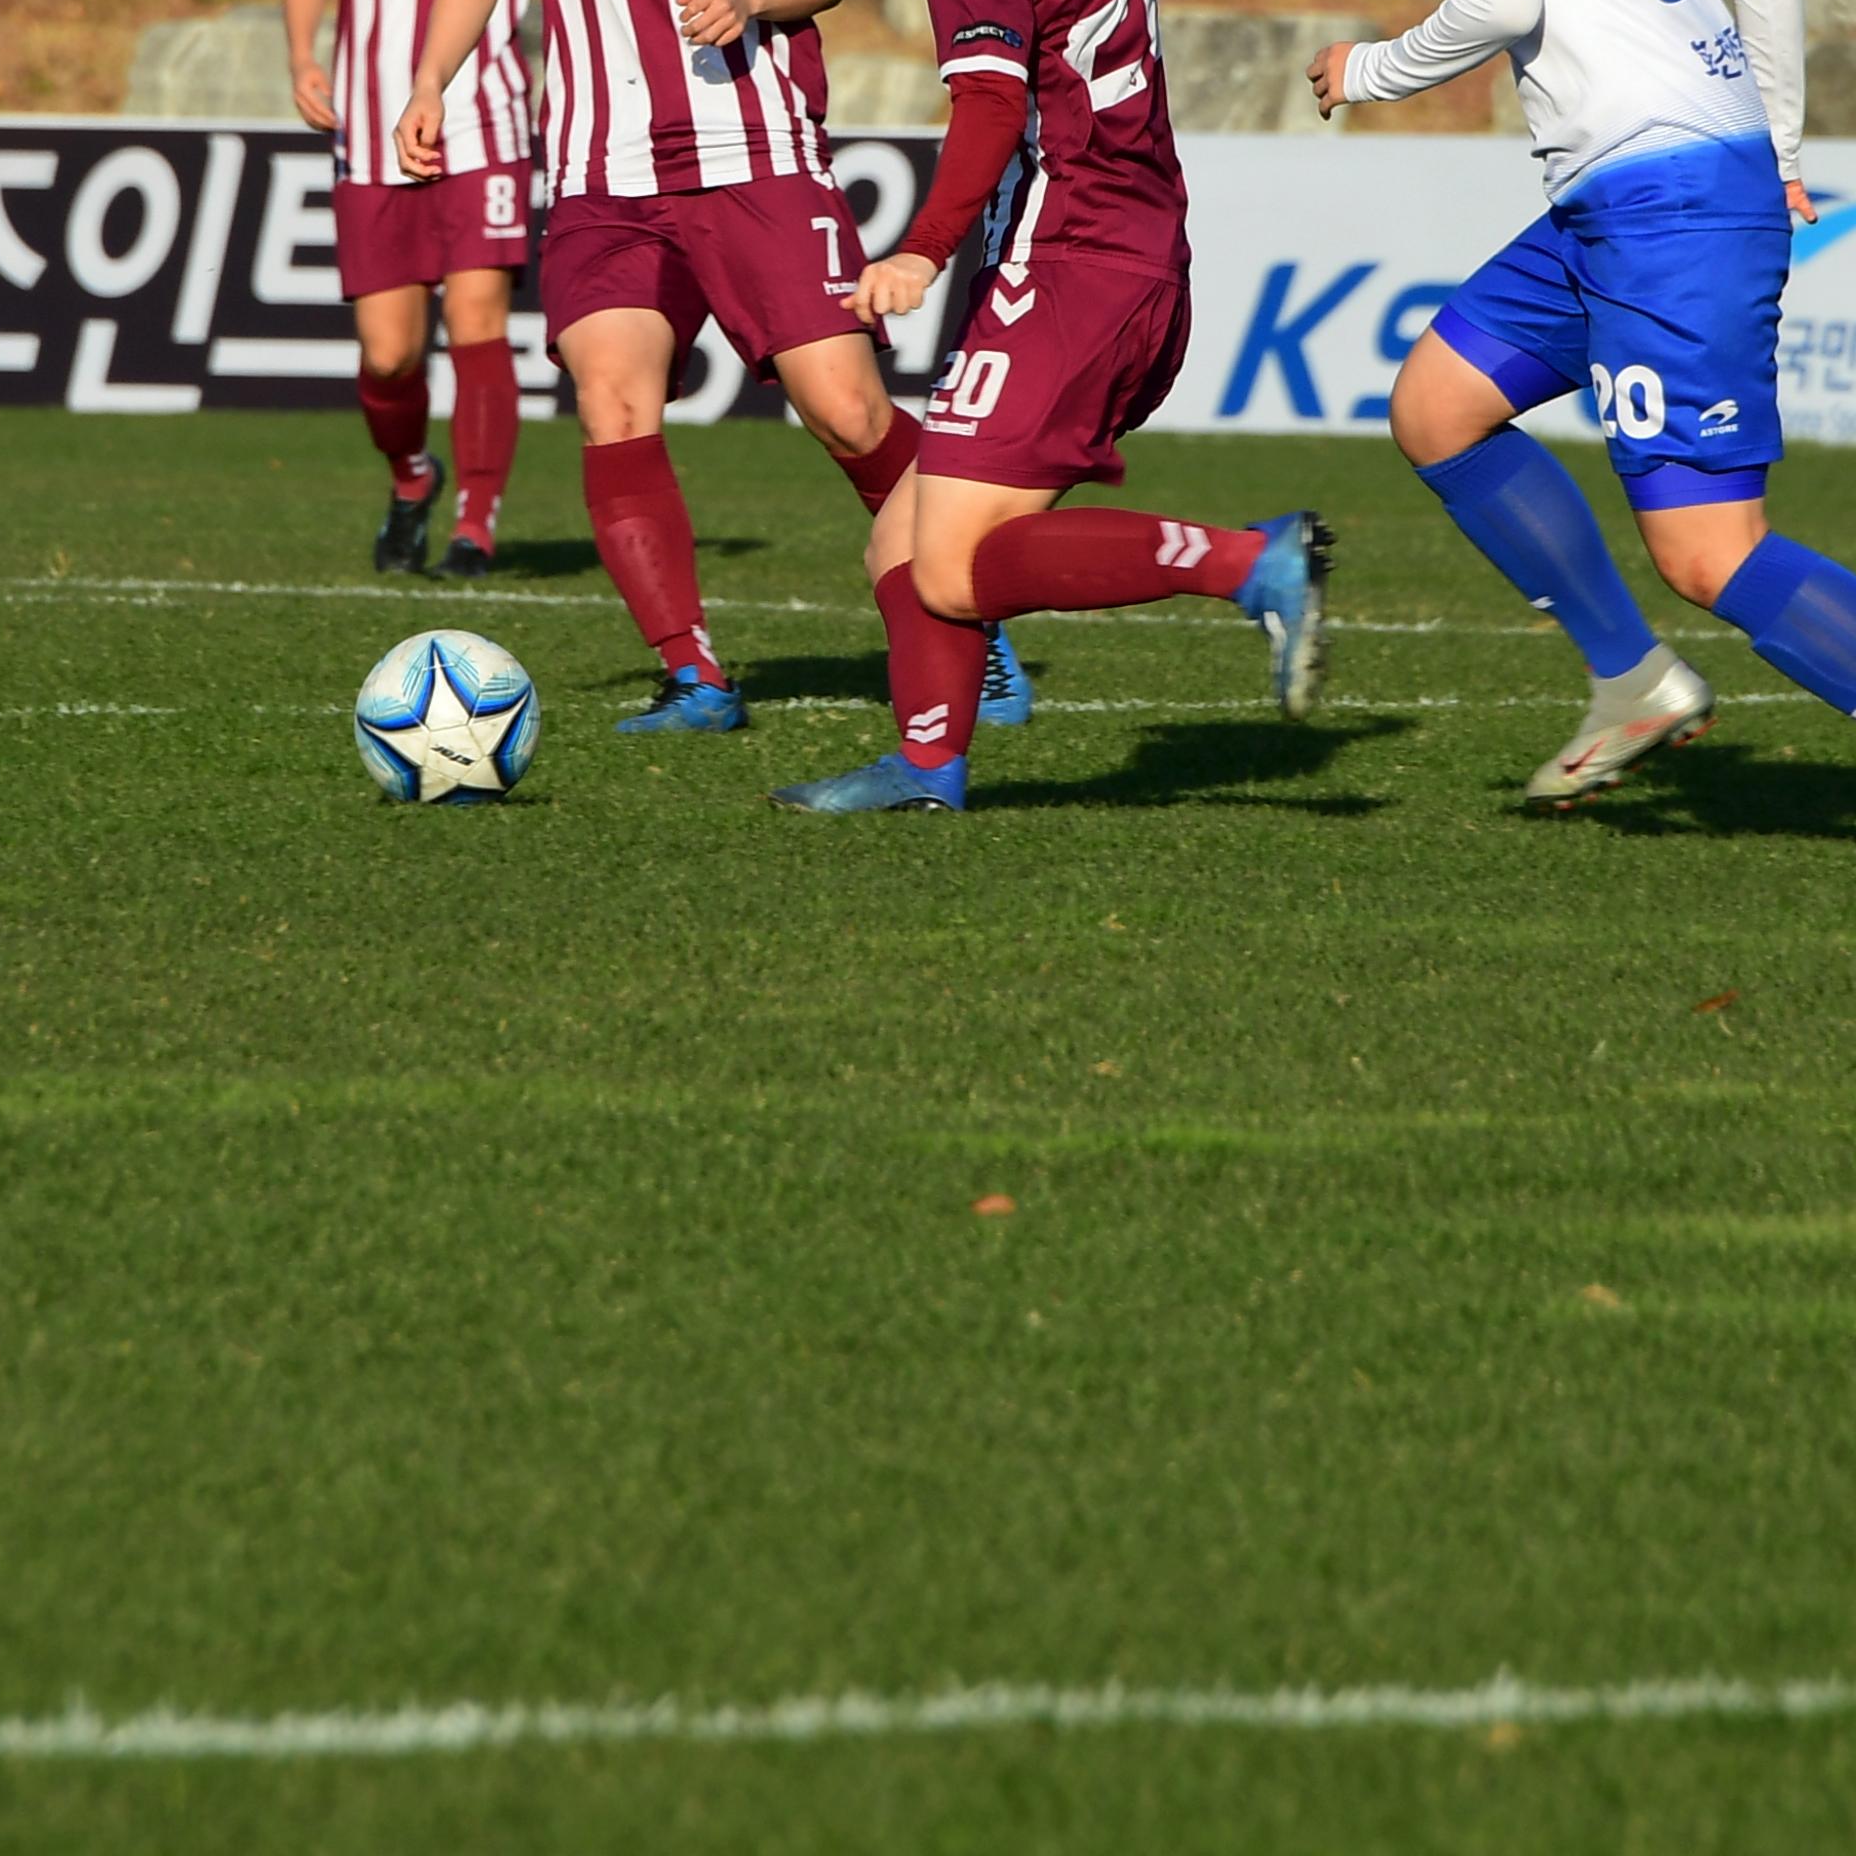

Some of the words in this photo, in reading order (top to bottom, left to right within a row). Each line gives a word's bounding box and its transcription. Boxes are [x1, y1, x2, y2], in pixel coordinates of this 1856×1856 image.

[484, 174, 517, 226] 8
[810, 216, 842, 277] 7
[927, 350, 1012, 419] 20
[1590, 363, 1666, 440] 20
